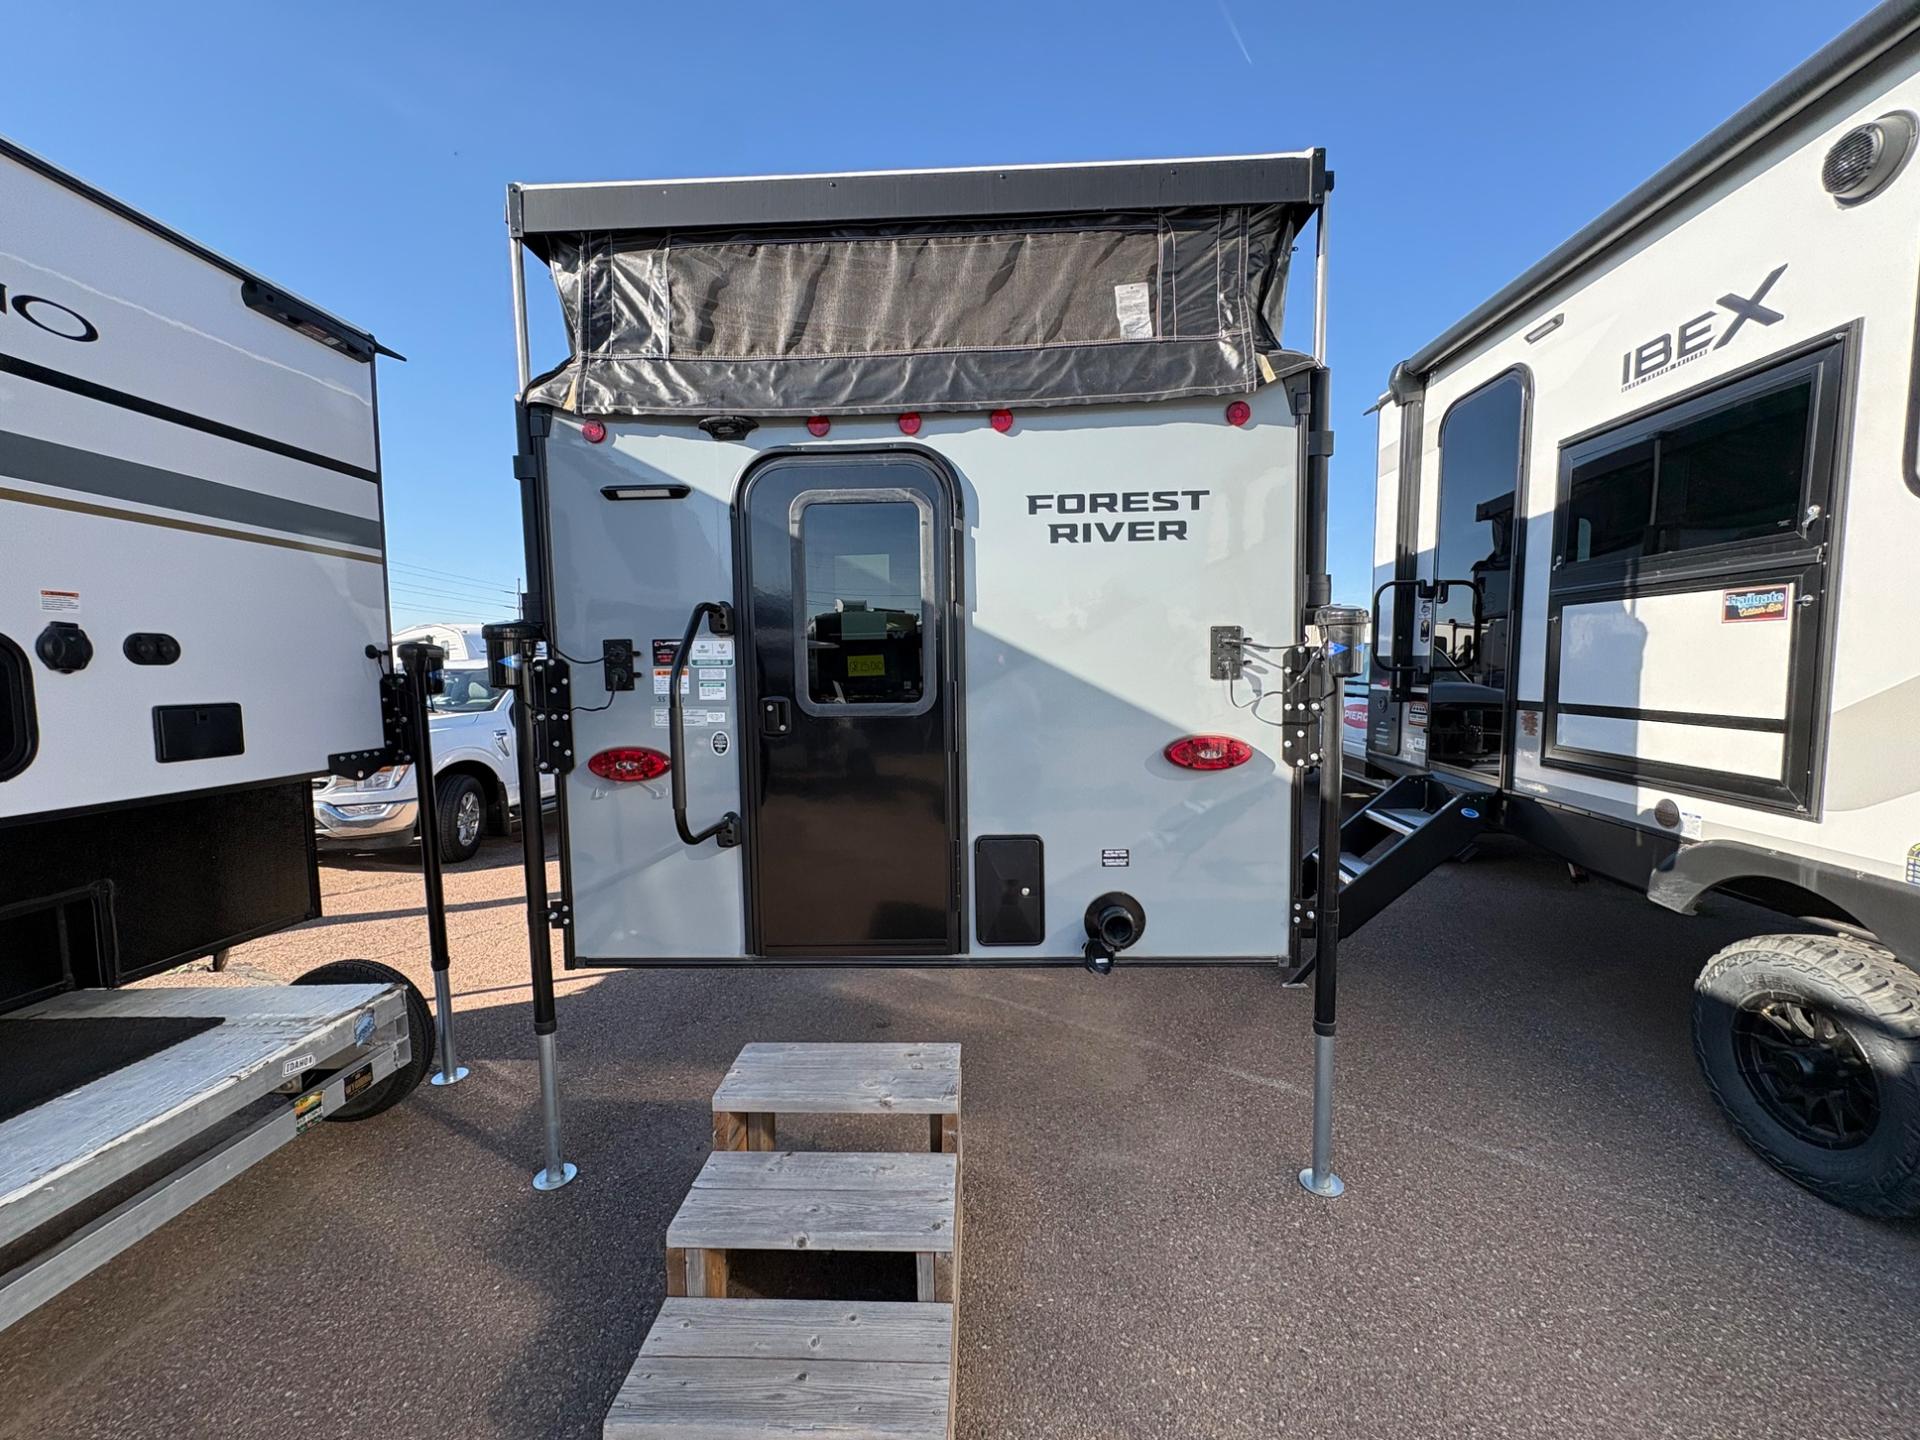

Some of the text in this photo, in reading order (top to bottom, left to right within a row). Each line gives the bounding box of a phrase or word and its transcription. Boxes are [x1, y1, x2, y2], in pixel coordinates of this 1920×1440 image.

[1622, 263, 1788, 385] IBEX
[1025, 490, 1210, 515] FOREST
[1047, 520, 1188, 544] RIVER
